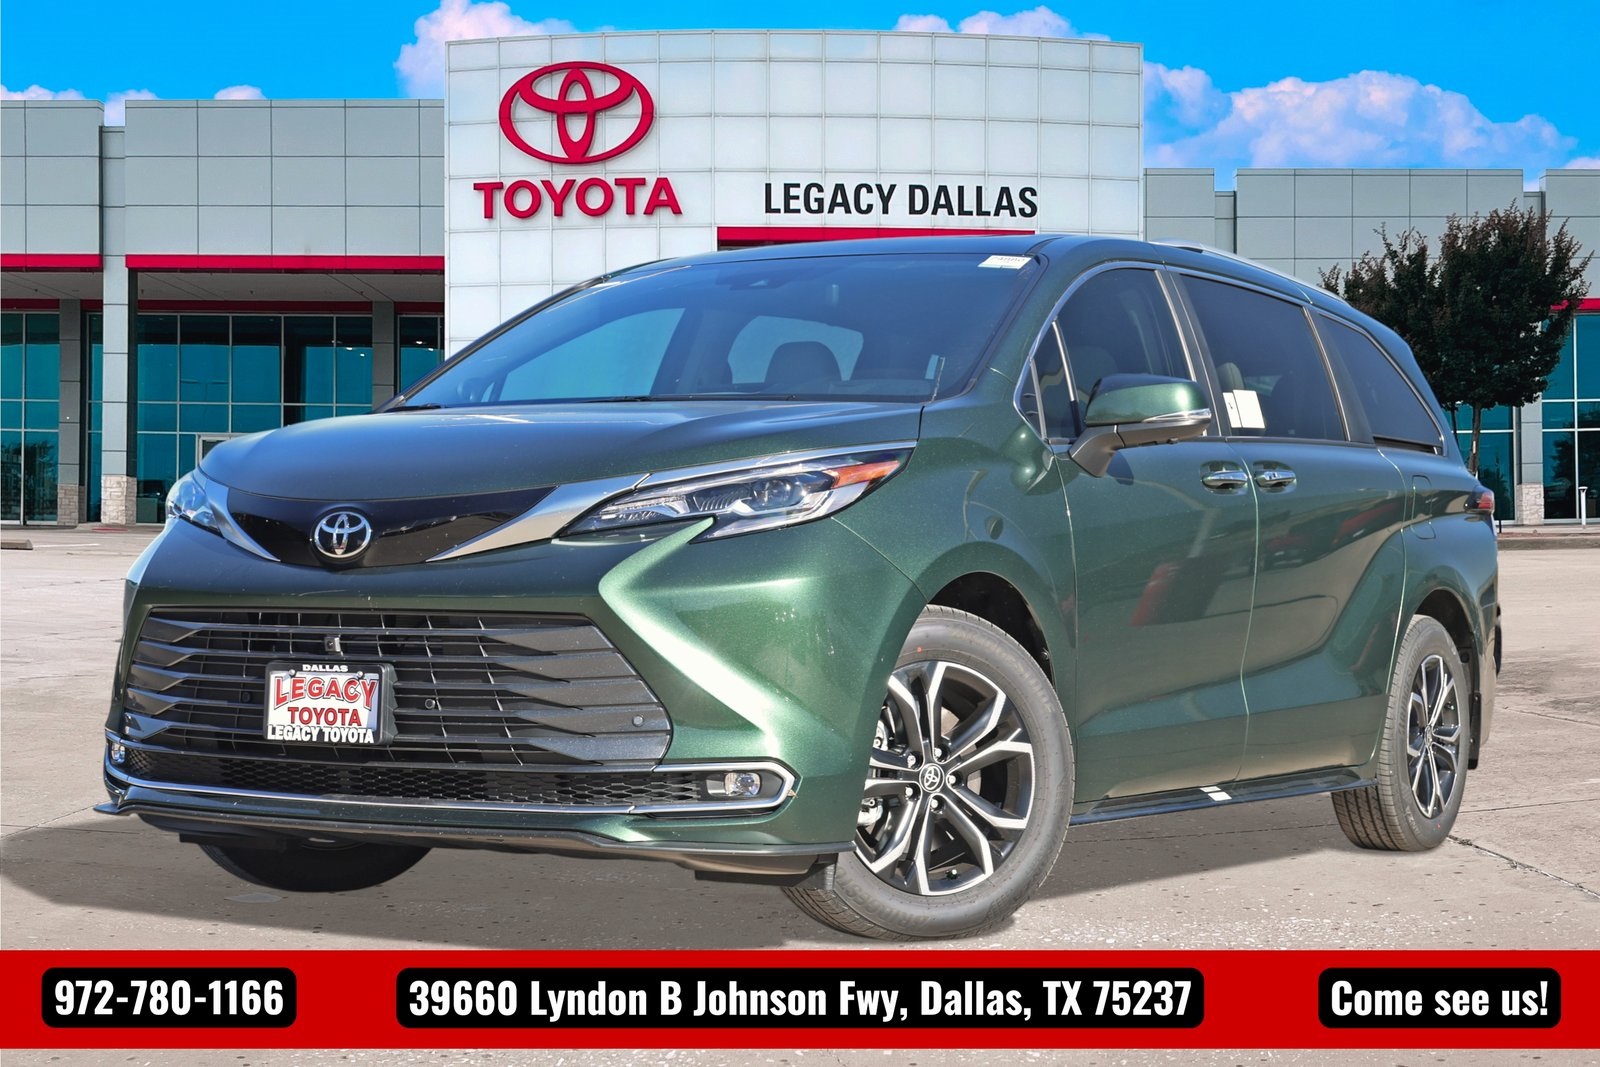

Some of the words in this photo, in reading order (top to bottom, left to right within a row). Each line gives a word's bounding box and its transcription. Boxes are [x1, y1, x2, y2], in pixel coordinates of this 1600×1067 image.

[474, 177, 683, 219] TOYOTA
[764, 182, 898, 215] LEGACY
[908, 184, 1038, 217] DALLAS
[302, 664, 348, 672] DALLAS
[274, 676, 378, 710] LEGACY
[288, 707, 362, 726] TOYOTA
[267, 725, 320, 742] LEGACY
[322, 727, 374, 743] TOYOTA
